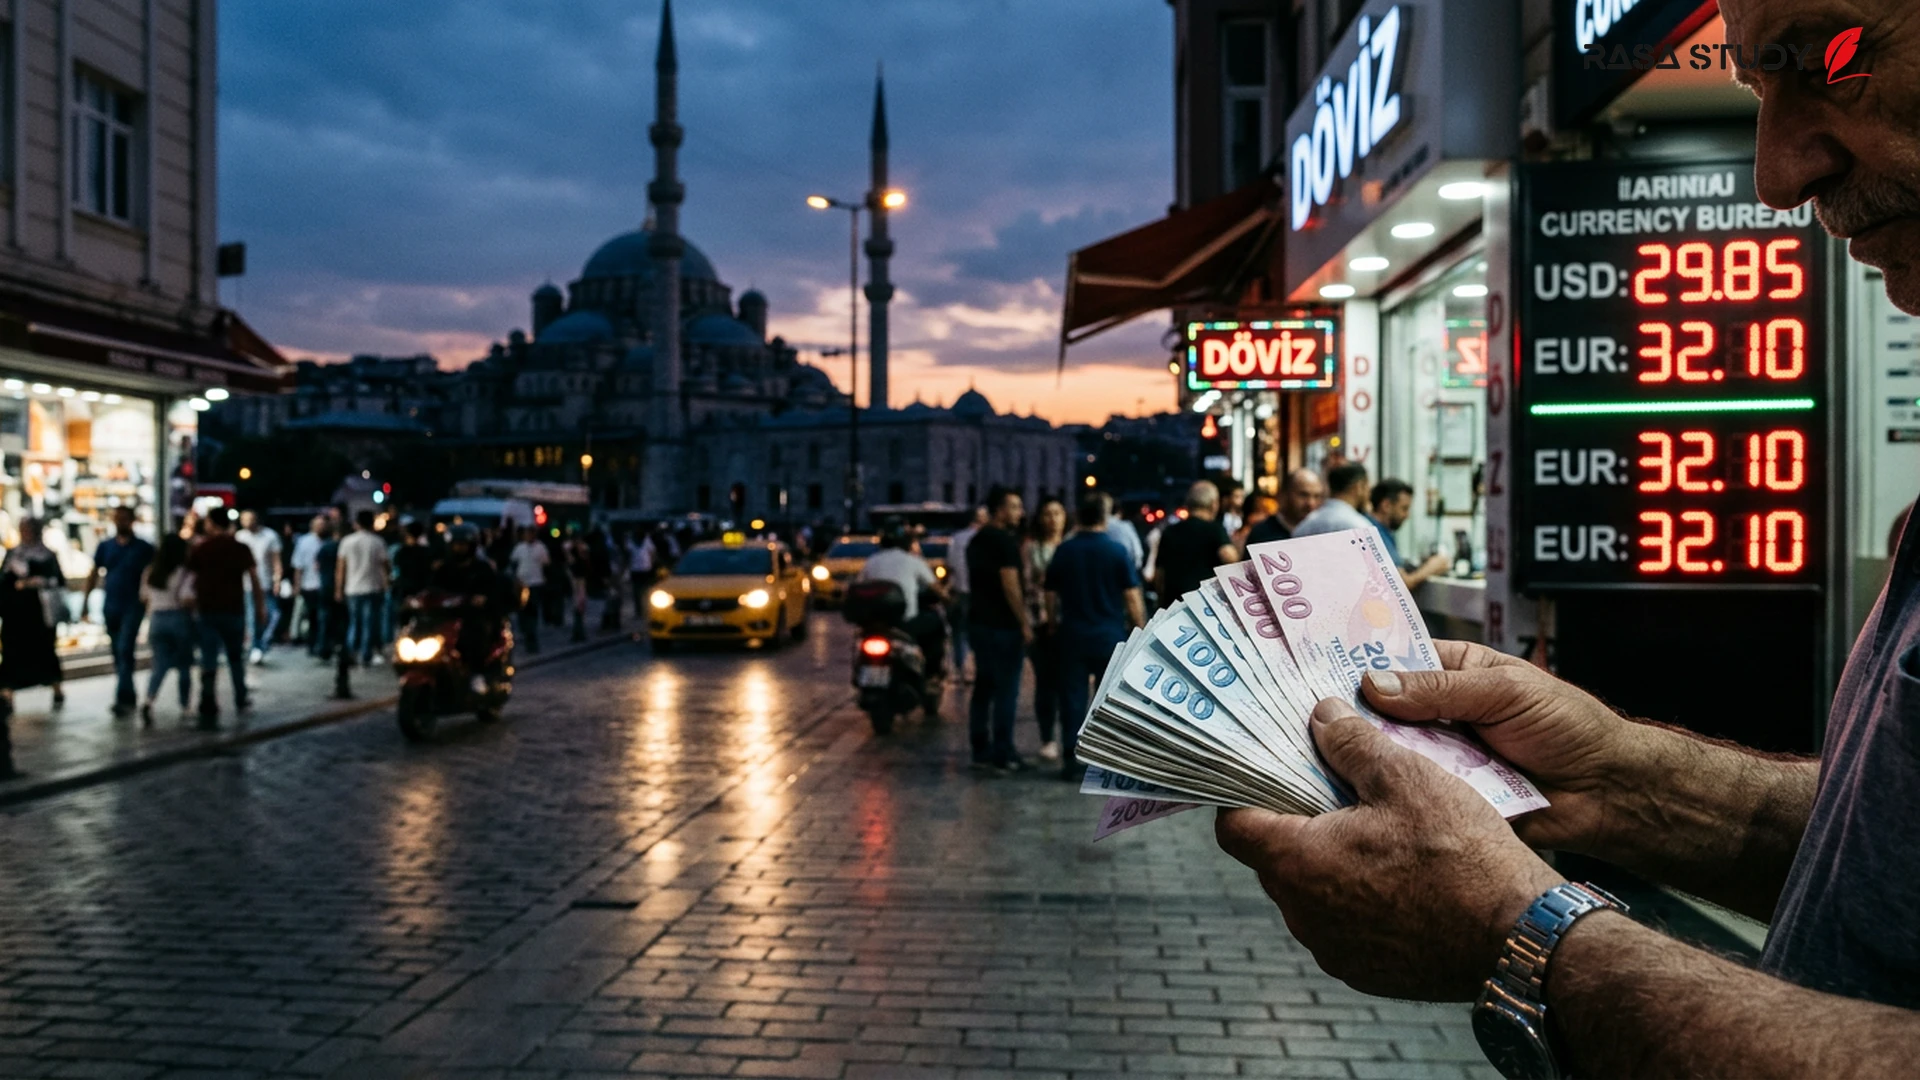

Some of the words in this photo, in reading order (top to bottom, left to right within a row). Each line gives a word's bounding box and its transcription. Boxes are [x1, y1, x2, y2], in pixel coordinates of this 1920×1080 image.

[1292, 5, 1400, 231] DÖVİZ
[1540, 205, 1690, 237] CURRENCY
[1696, 200, 1812, 231] BUREAU
[1534, 262, 1629, 300] USD:
[1634, 239, 1803, 304] 29.85
[1203, 331, 1317, 376] DÖVİZ
[1534, 336, 1629, 374] EUR:
[1638, 318, 1804, 382] 32.10
[1534, 449, 1629, 486] EUR:
[1638, 430, 1804, 492] 32.10
[1534, 525, 1629, 562] EUR:
[1638, 510, 1804, 573] 32.10
[1228, 574, 1282, 640] 200
[1259, 551, 1313, 620] 200
[1173, 624, 1237, 688] 100
[1143, 664, 1215, 721] 100
[1107, 800, 1156, 829] 200
